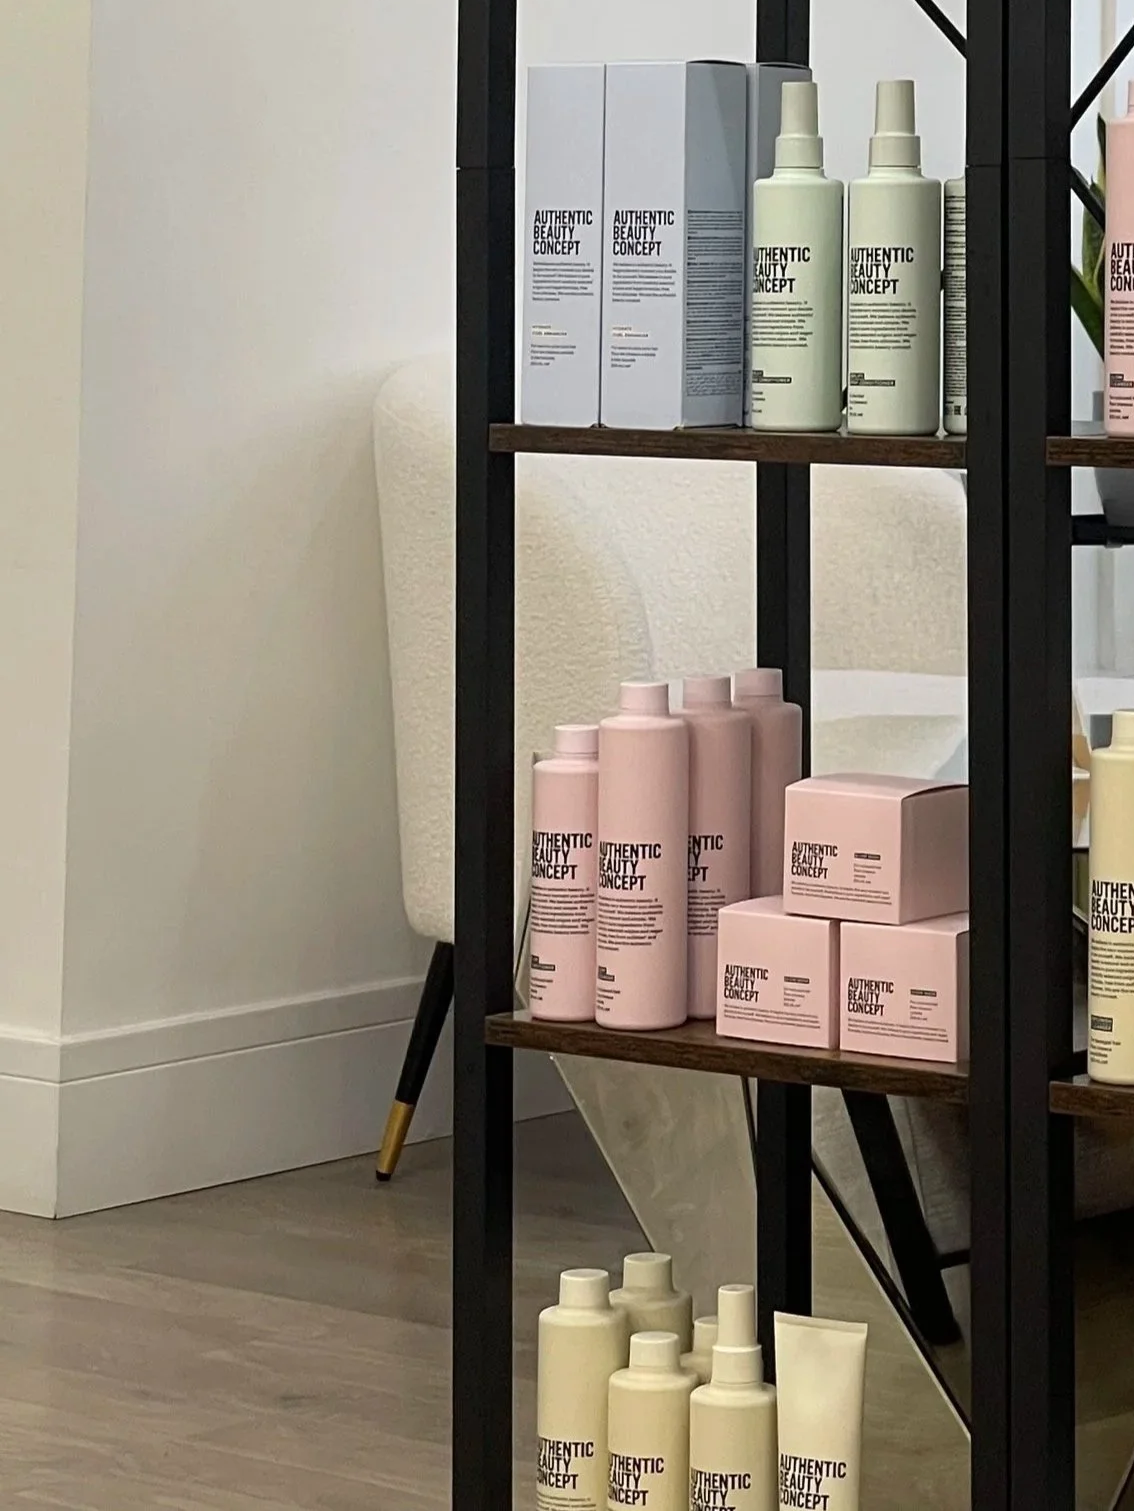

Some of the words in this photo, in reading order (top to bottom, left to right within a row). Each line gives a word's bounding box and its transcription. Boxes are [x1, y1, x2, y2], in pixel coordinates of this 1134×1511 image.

[534, 210, 593, 225] AUTHENTIC
[613, 210, 674, 225] AUTHENTIC
[534, 226, 574, 240] BEAUTY
[613, 226, 656, 241] BEAUTY
[533, 241, 580, 255] CONCEPT
[613, 241, 662, 256] CONCEPT
[792, 841, 838, 857] AUTHENTIC
[792, 853, 824, 867] BEAUTY
[791, 864, 828, 879] CONCEPT
[725, 964, 768, 980] AUTHENTIC
[725, 976, 754, 990] BEAUTY
[849, 978, 894, 994] AUTHENTIC
[724, 987, 759, 1003] CONCEPT
[848, 990, 880, 1004] BEAUTY
[848, 1002, 884, 1016] CONCEPT
[780, 1453, 846, 1478] AUTHENTIC
